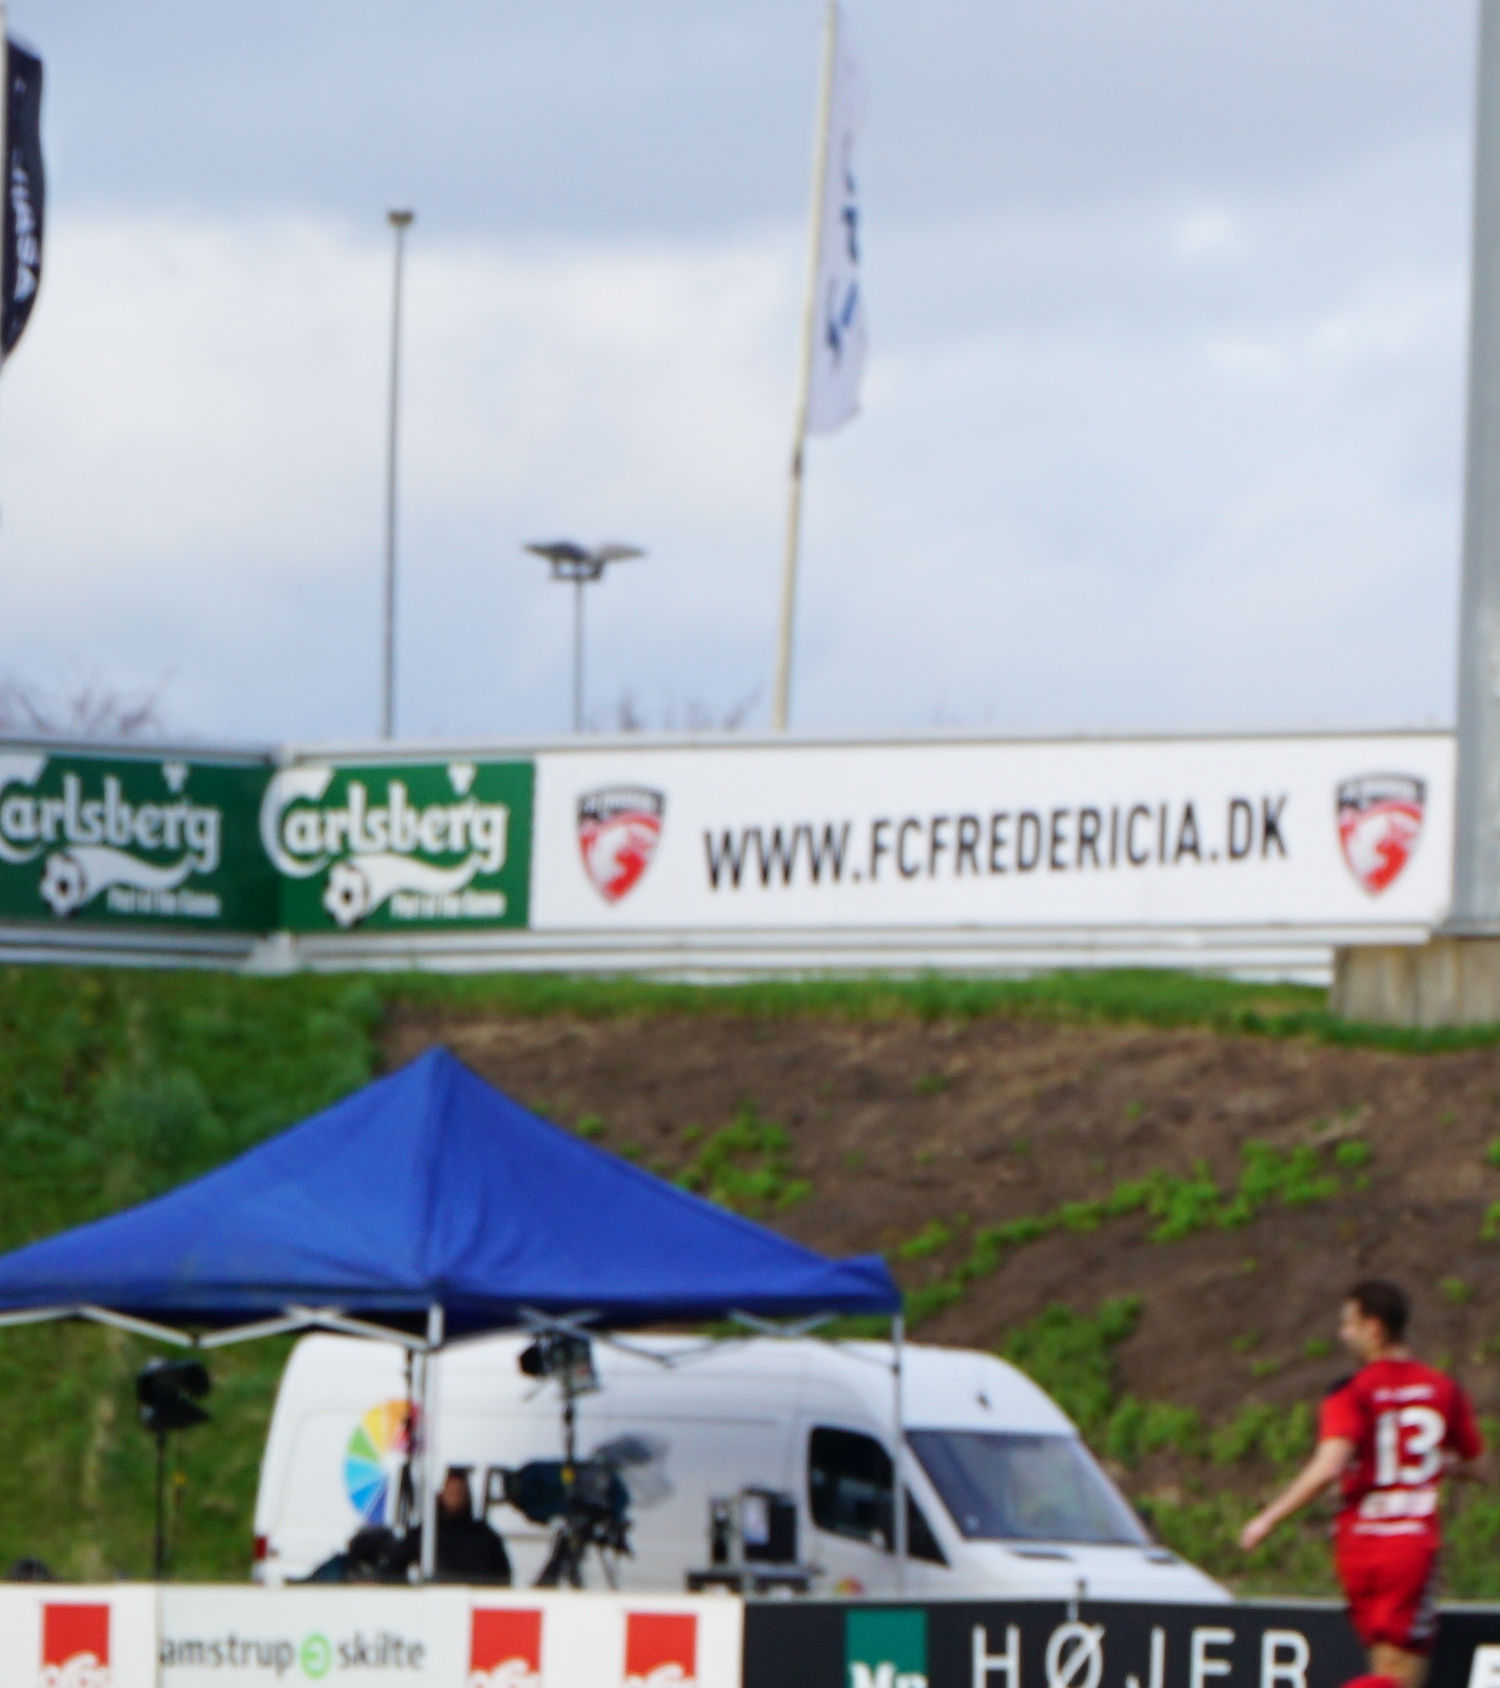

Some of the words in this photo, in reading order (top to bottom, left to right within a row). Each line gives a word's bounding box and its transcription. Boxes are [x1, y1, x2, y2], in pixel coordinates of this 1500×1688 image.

[261, 765, 508, 876] Carlsberg
[704, 796, 1290, 890] WWW.FCFREDERICIA.DK
[1375, 1406, 1447, 1487] 13
[158, 1631, 294, 1679] amstrup
[337, 1631, 426, 1671] skilte
